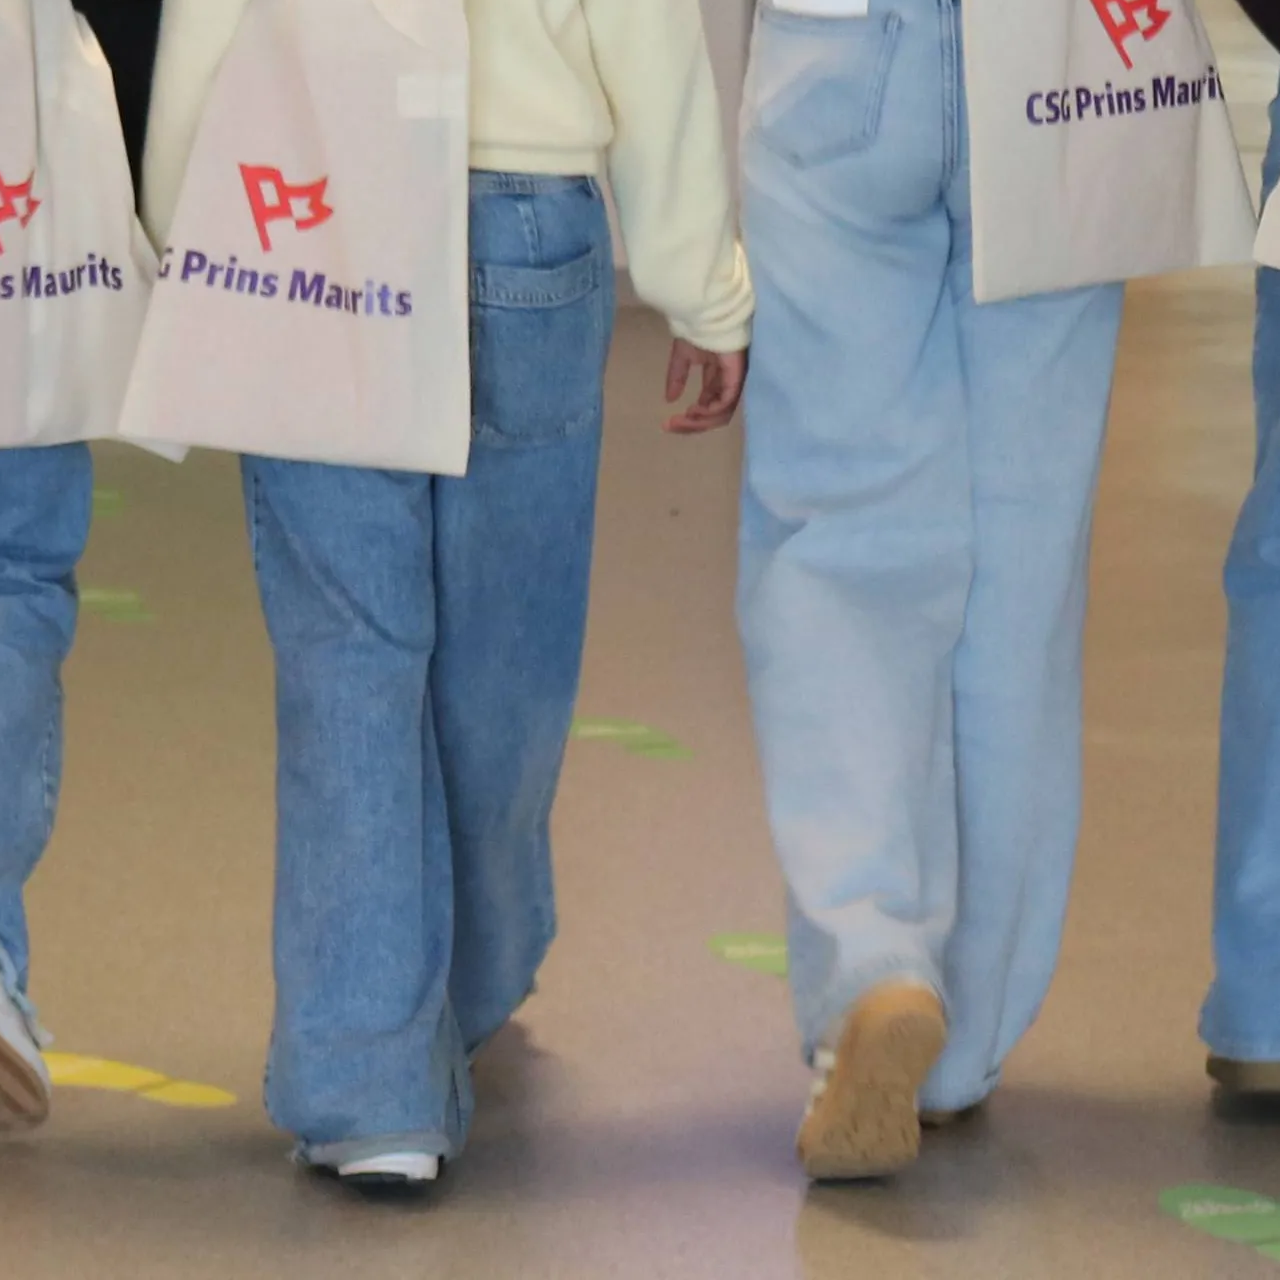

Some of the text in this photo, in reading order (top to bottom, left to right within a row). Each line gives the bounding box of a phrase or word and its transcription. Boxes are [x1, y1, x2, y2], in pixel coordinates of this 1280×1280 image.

[1075, 81, 1146, 120] Prins
[22, 253, 124, 299] Maurits
[180, 249, 279, 298] Prins
